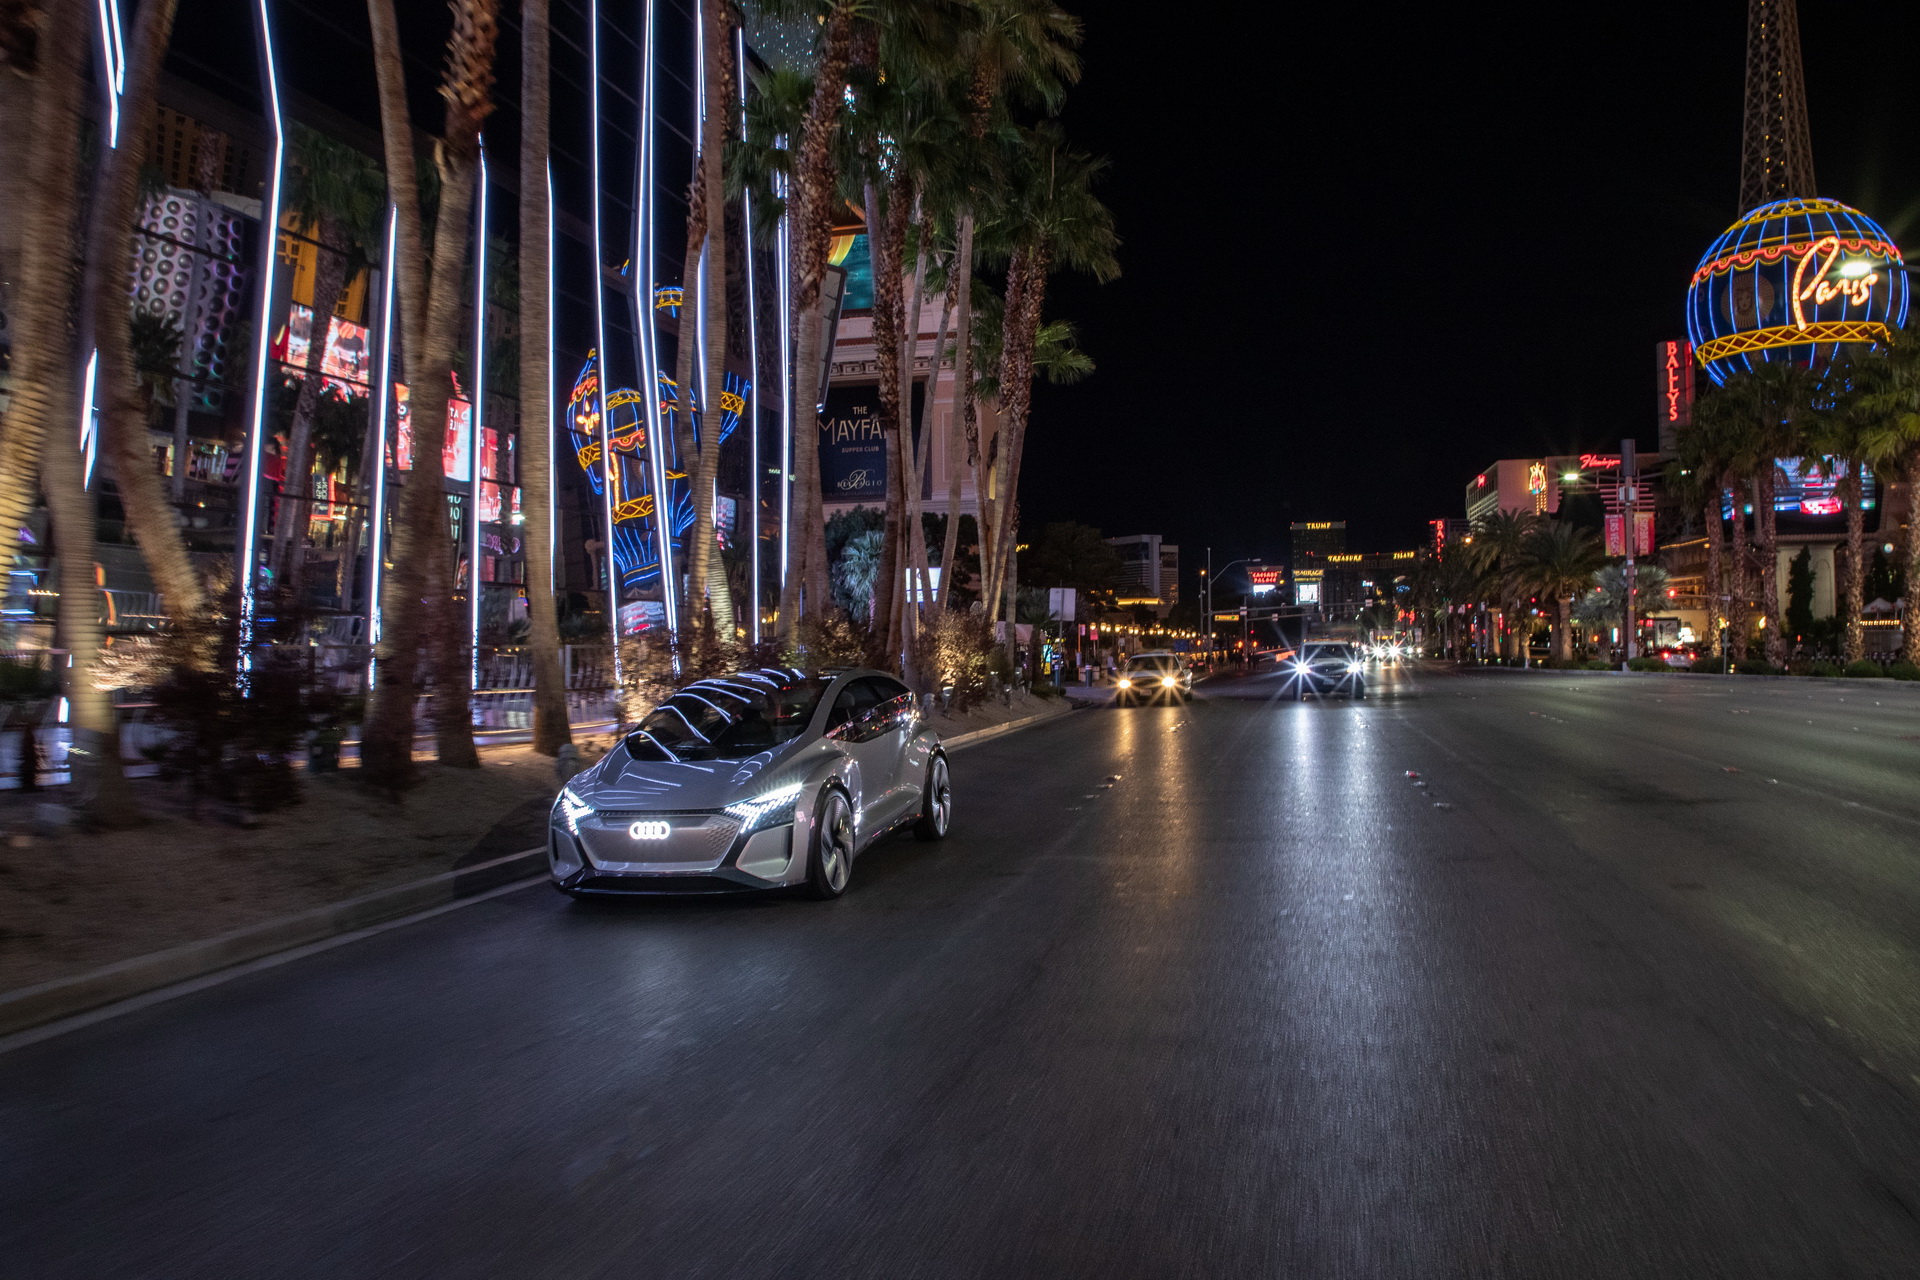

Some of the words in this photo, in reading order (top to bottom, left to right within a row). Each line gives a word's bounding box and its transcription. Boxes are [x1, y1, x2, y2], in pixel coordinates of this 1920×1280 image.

[1791, 235, 1879, 332] Paris
[1666, 341, 1681, 422] BALLYS
[852, 406, 868, 415] THE
[1580, 454, 1621, 470] Flamingo
[1306, 522, 1331, 530] TRUMP
[1609, 519, 1619, 532] LAS
[1639, 518, 1649, 539] VEGAS
[1610, 532, 1620, 554] VEGAS
[1327, 554, 1363, 562] TREASURE
[1392, 551, 1415, 560] ISLAND
